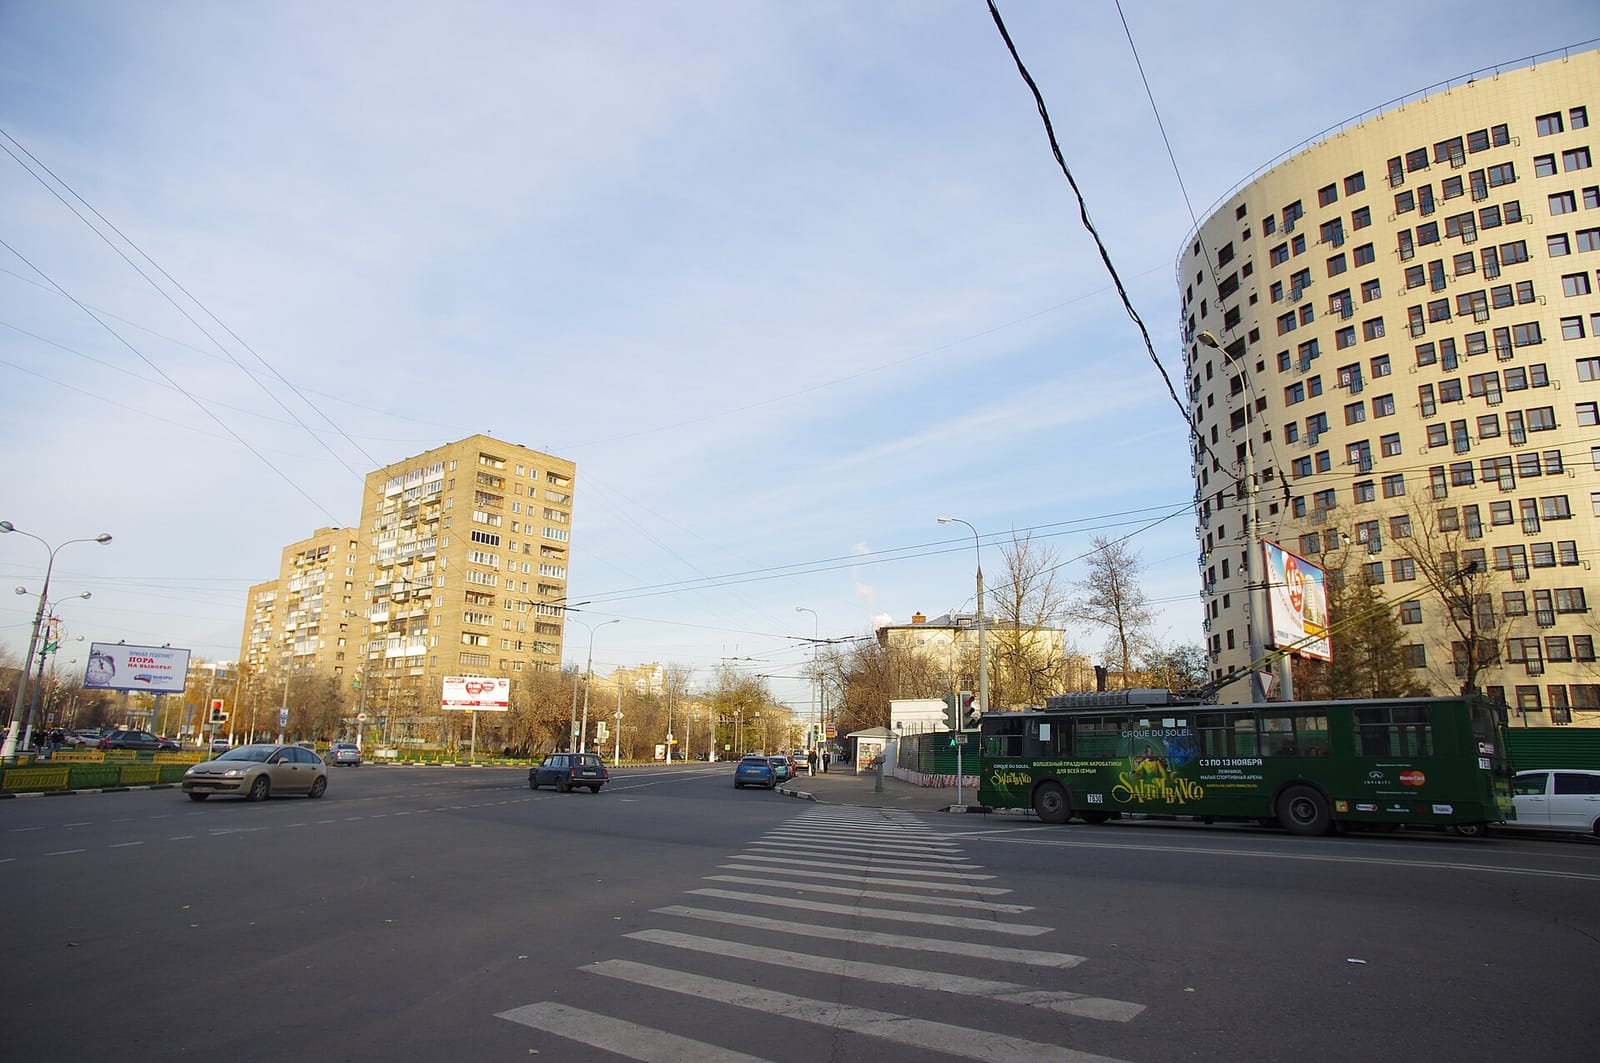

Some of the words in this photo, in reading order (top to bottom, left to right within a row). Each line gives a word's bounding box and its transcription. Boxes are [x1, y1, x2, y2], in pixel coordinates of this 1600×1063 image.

[1121, 729, 1151, 740] CRQUE
[1151, 729, 1164, 737] DU
[1204, 759, 1210, 767] 3
[1210, 759, 1221, 767] ПО
[1222, 759, 1231, 767] 13
[1231, 758, 1263, 767] НОЯБРЯ
